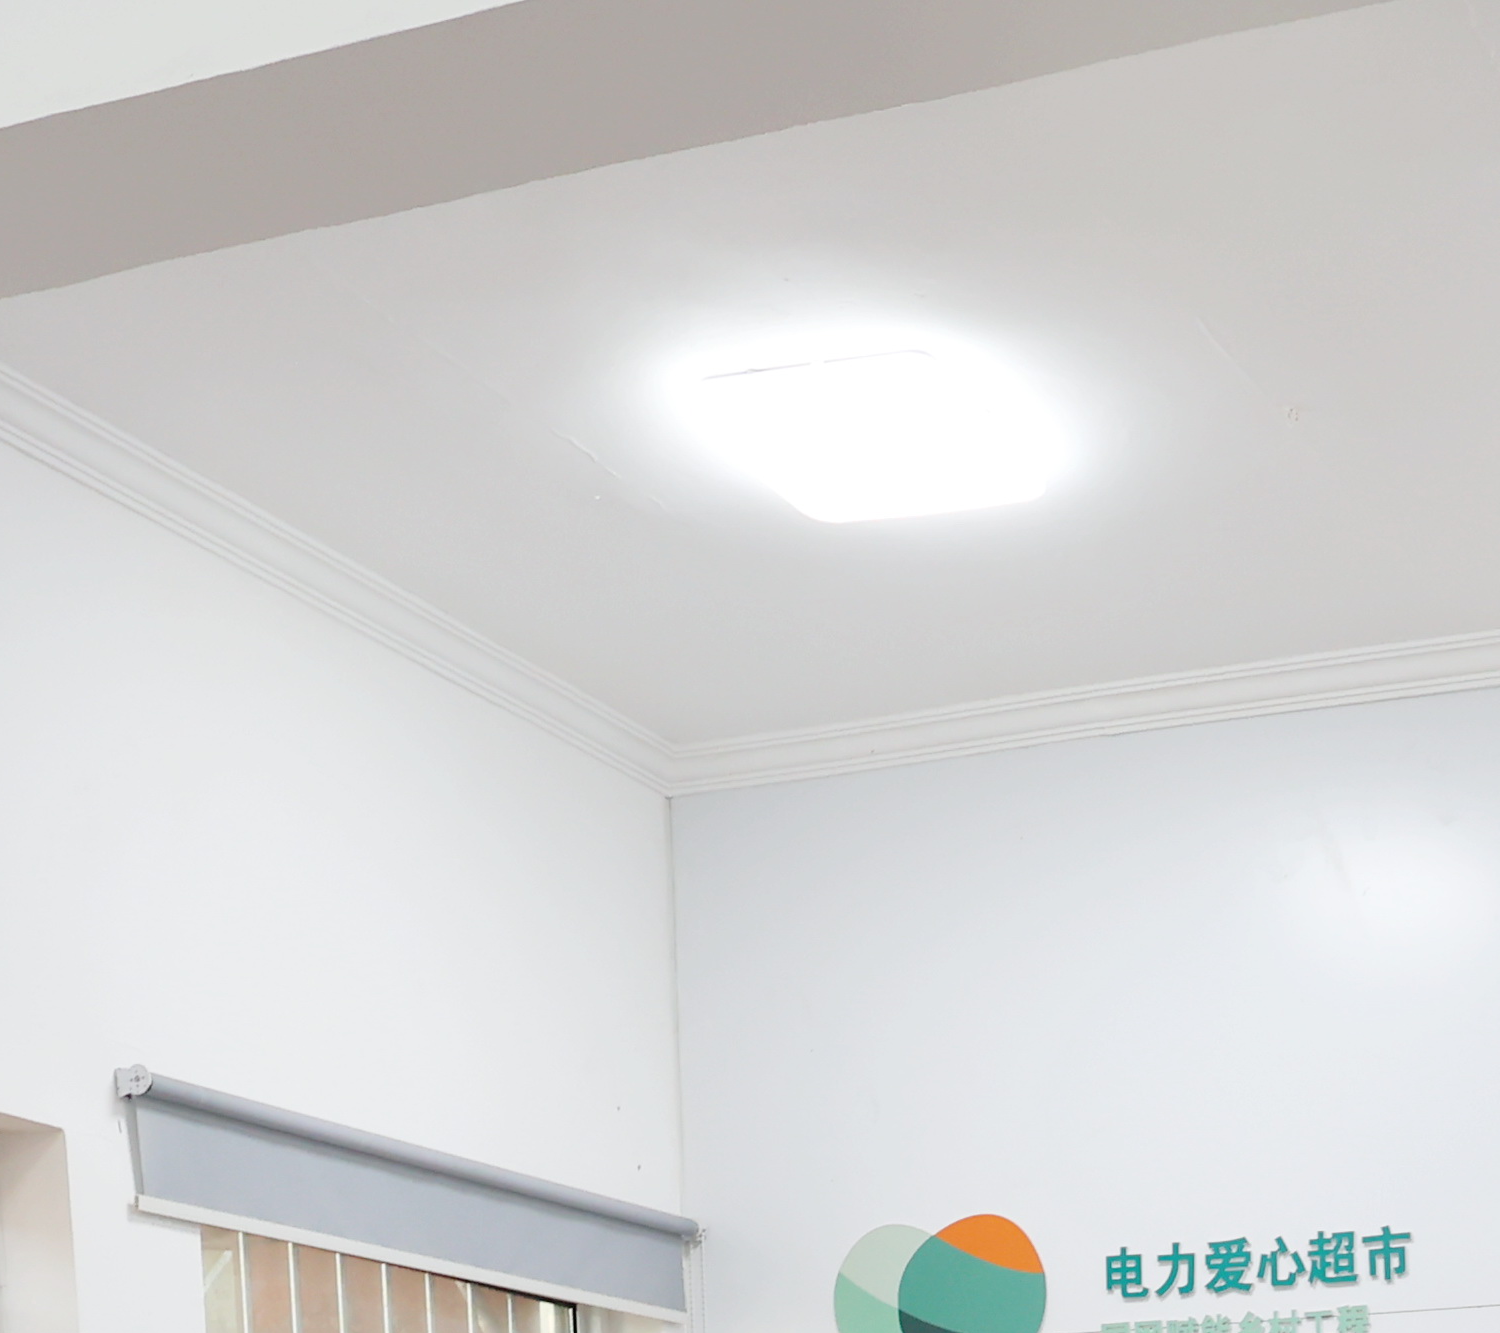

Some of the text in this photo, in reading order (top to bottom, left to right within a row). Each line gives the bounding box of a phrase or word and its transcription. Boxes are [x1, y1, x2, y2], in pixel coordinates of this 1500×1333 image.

[1104, 1226, 1412, 1299] 电力爱心超市
